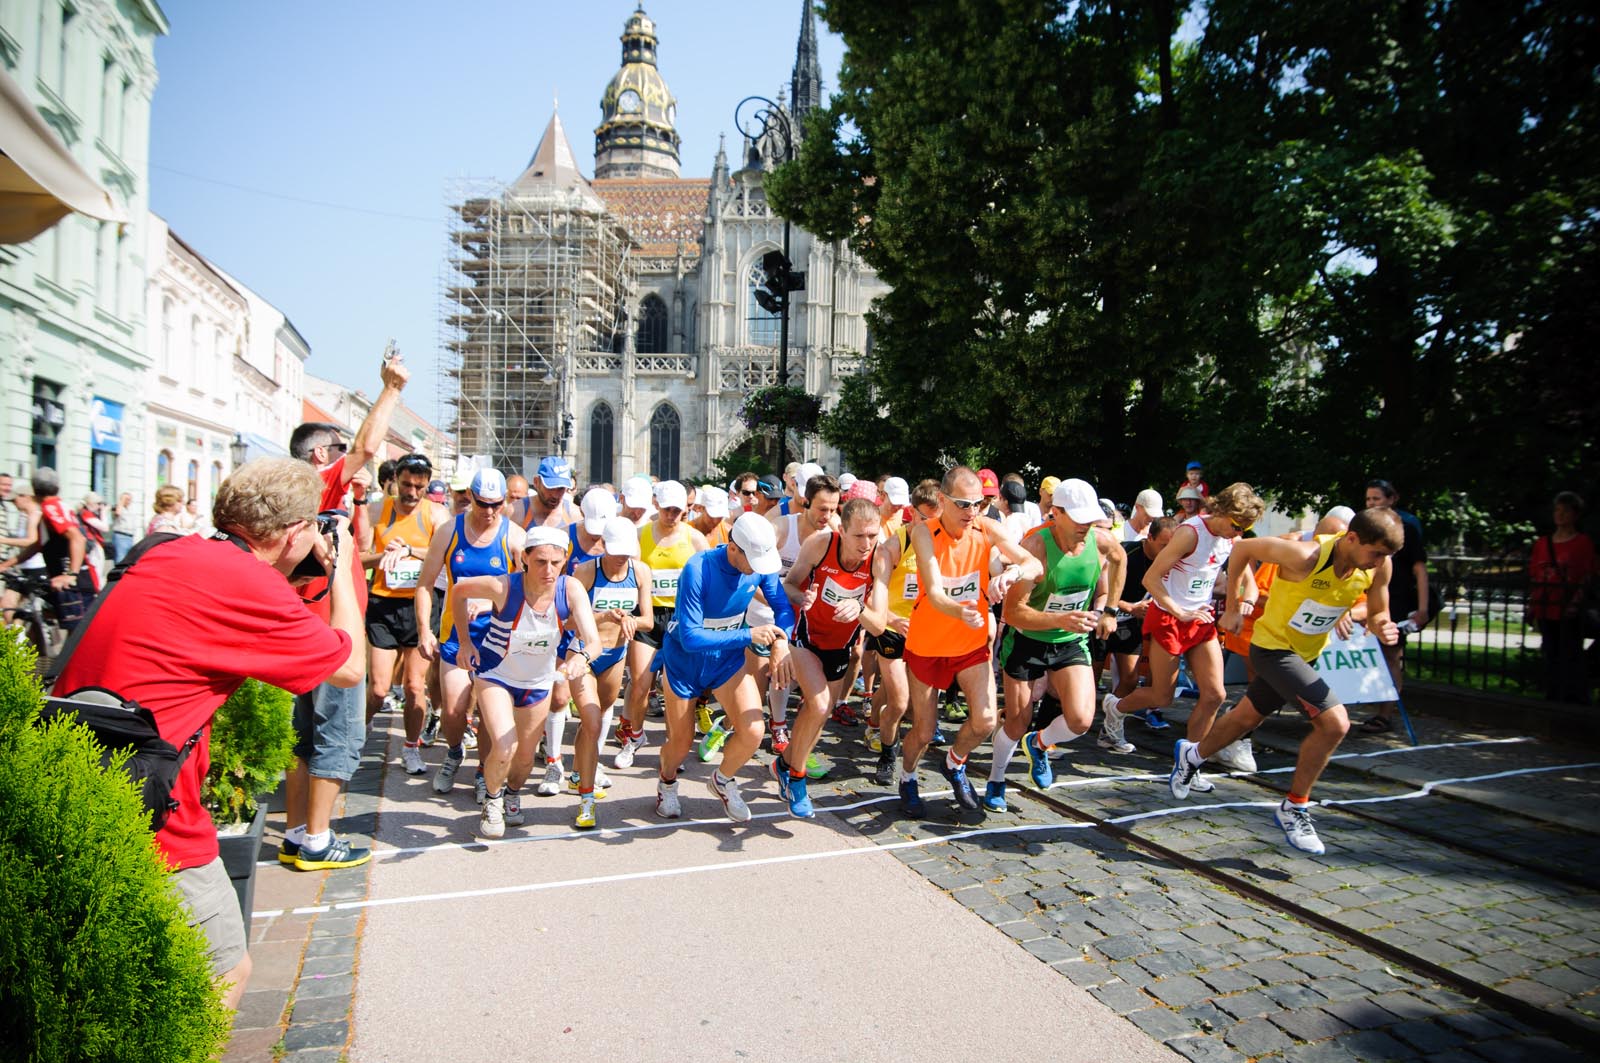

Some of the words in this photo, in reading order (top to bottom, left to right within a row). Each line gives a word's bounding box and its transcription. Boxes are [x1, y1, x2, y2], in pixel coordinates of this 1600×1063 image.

[652, 579, 678, 589] 162
[943, 581, 977, 597] 104
[594, 599, 634, 610] 232
[1302, 612, 1338, 627] 157
